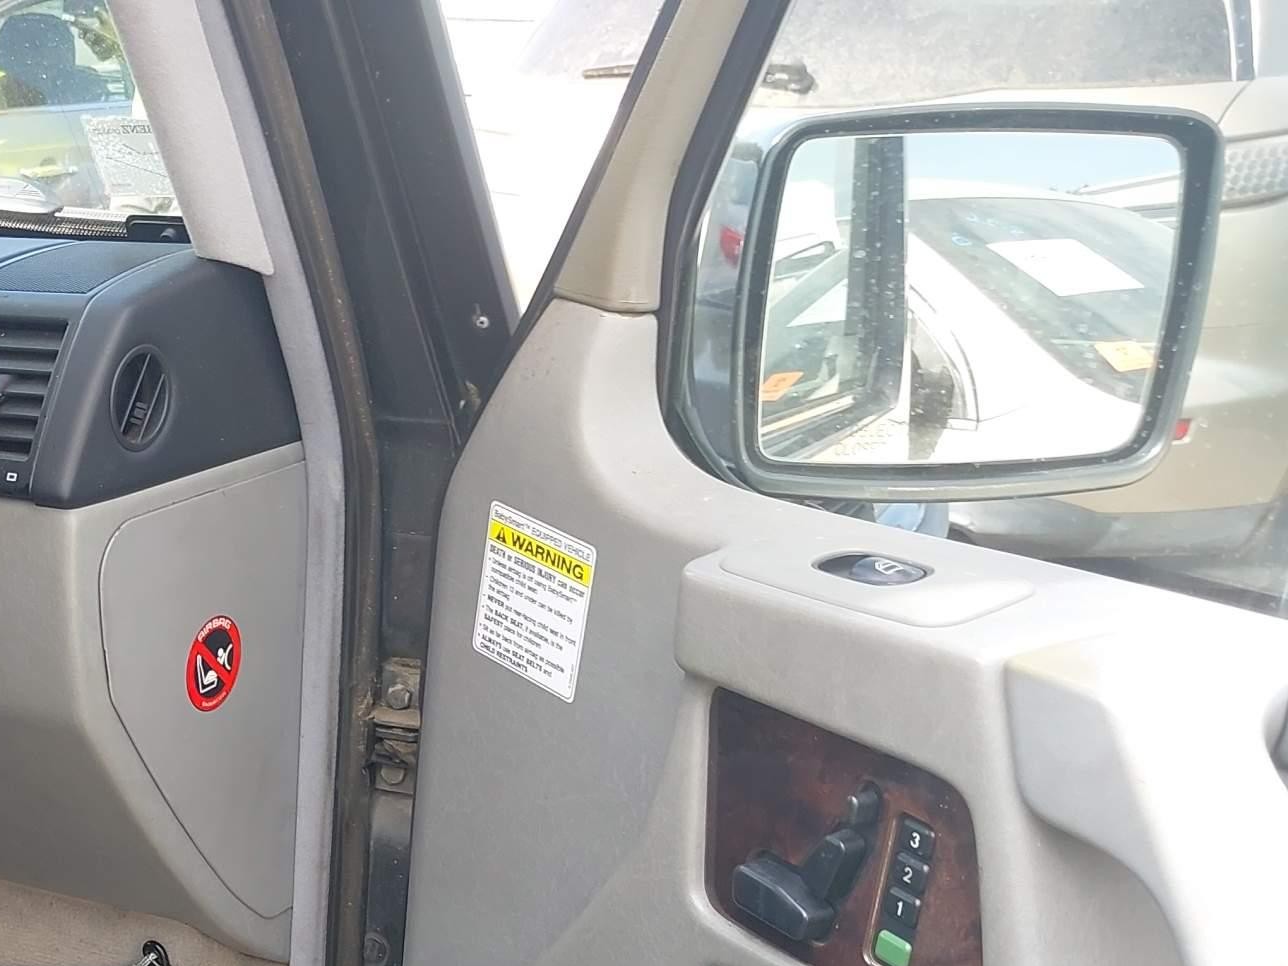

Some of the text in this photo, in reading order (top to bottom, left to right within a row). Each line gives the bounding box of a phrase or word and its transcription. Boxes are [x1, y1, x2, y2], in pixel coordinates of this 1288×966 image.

[509, 531, 585, 581] WARNING
[197, 617, 232, 643] AIRBAG
[910, 832, 921, 848] 3
[902, 867, 913, 883] 2
[896, 901, 903, 917] 1
